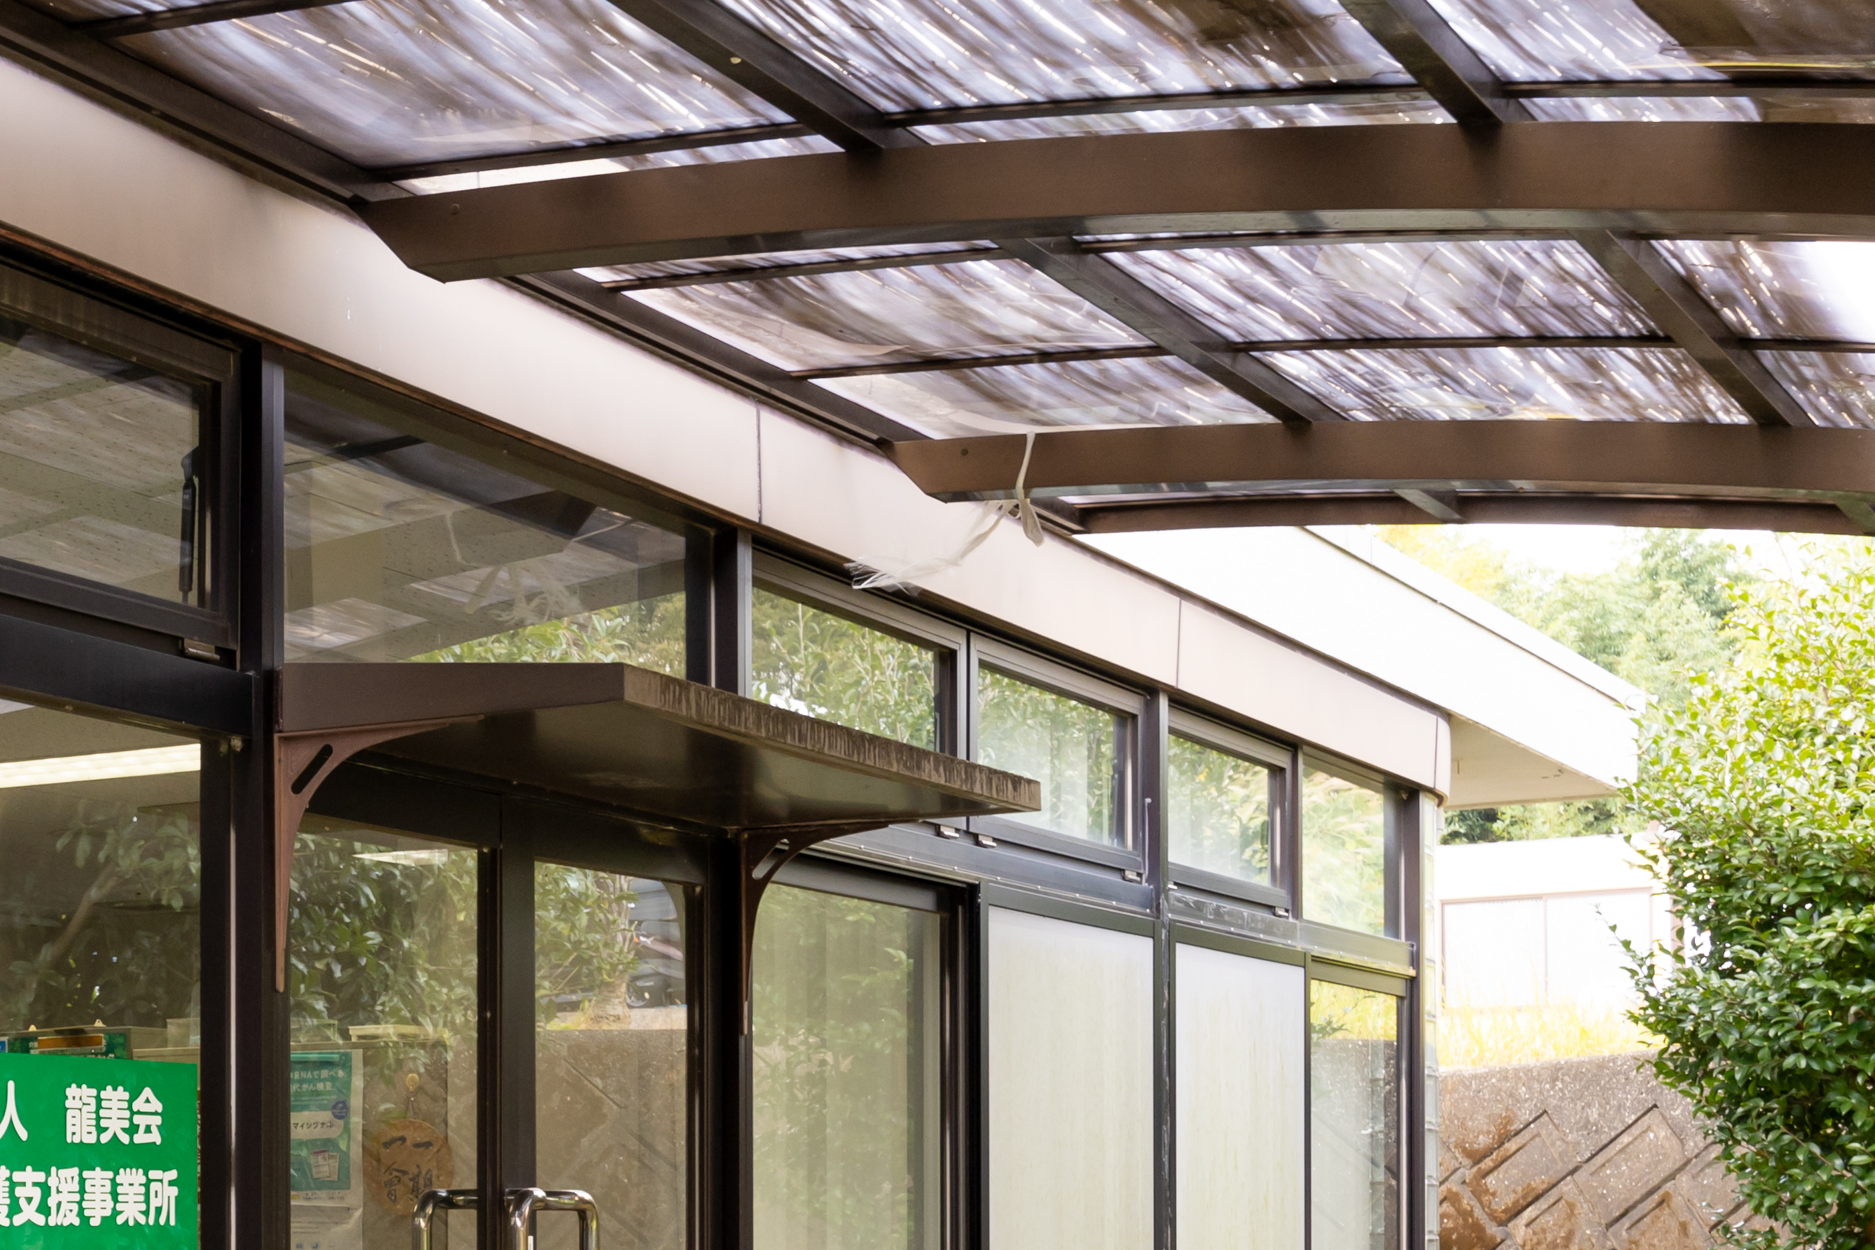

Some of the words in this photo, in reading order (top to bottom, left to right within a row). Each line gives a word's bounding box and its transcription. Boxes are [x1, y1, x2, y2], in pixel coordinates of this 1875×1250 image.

[65, 1083, 164, 1146] 龍美会
[292, 1121, 335, 1130] マイシグナル
